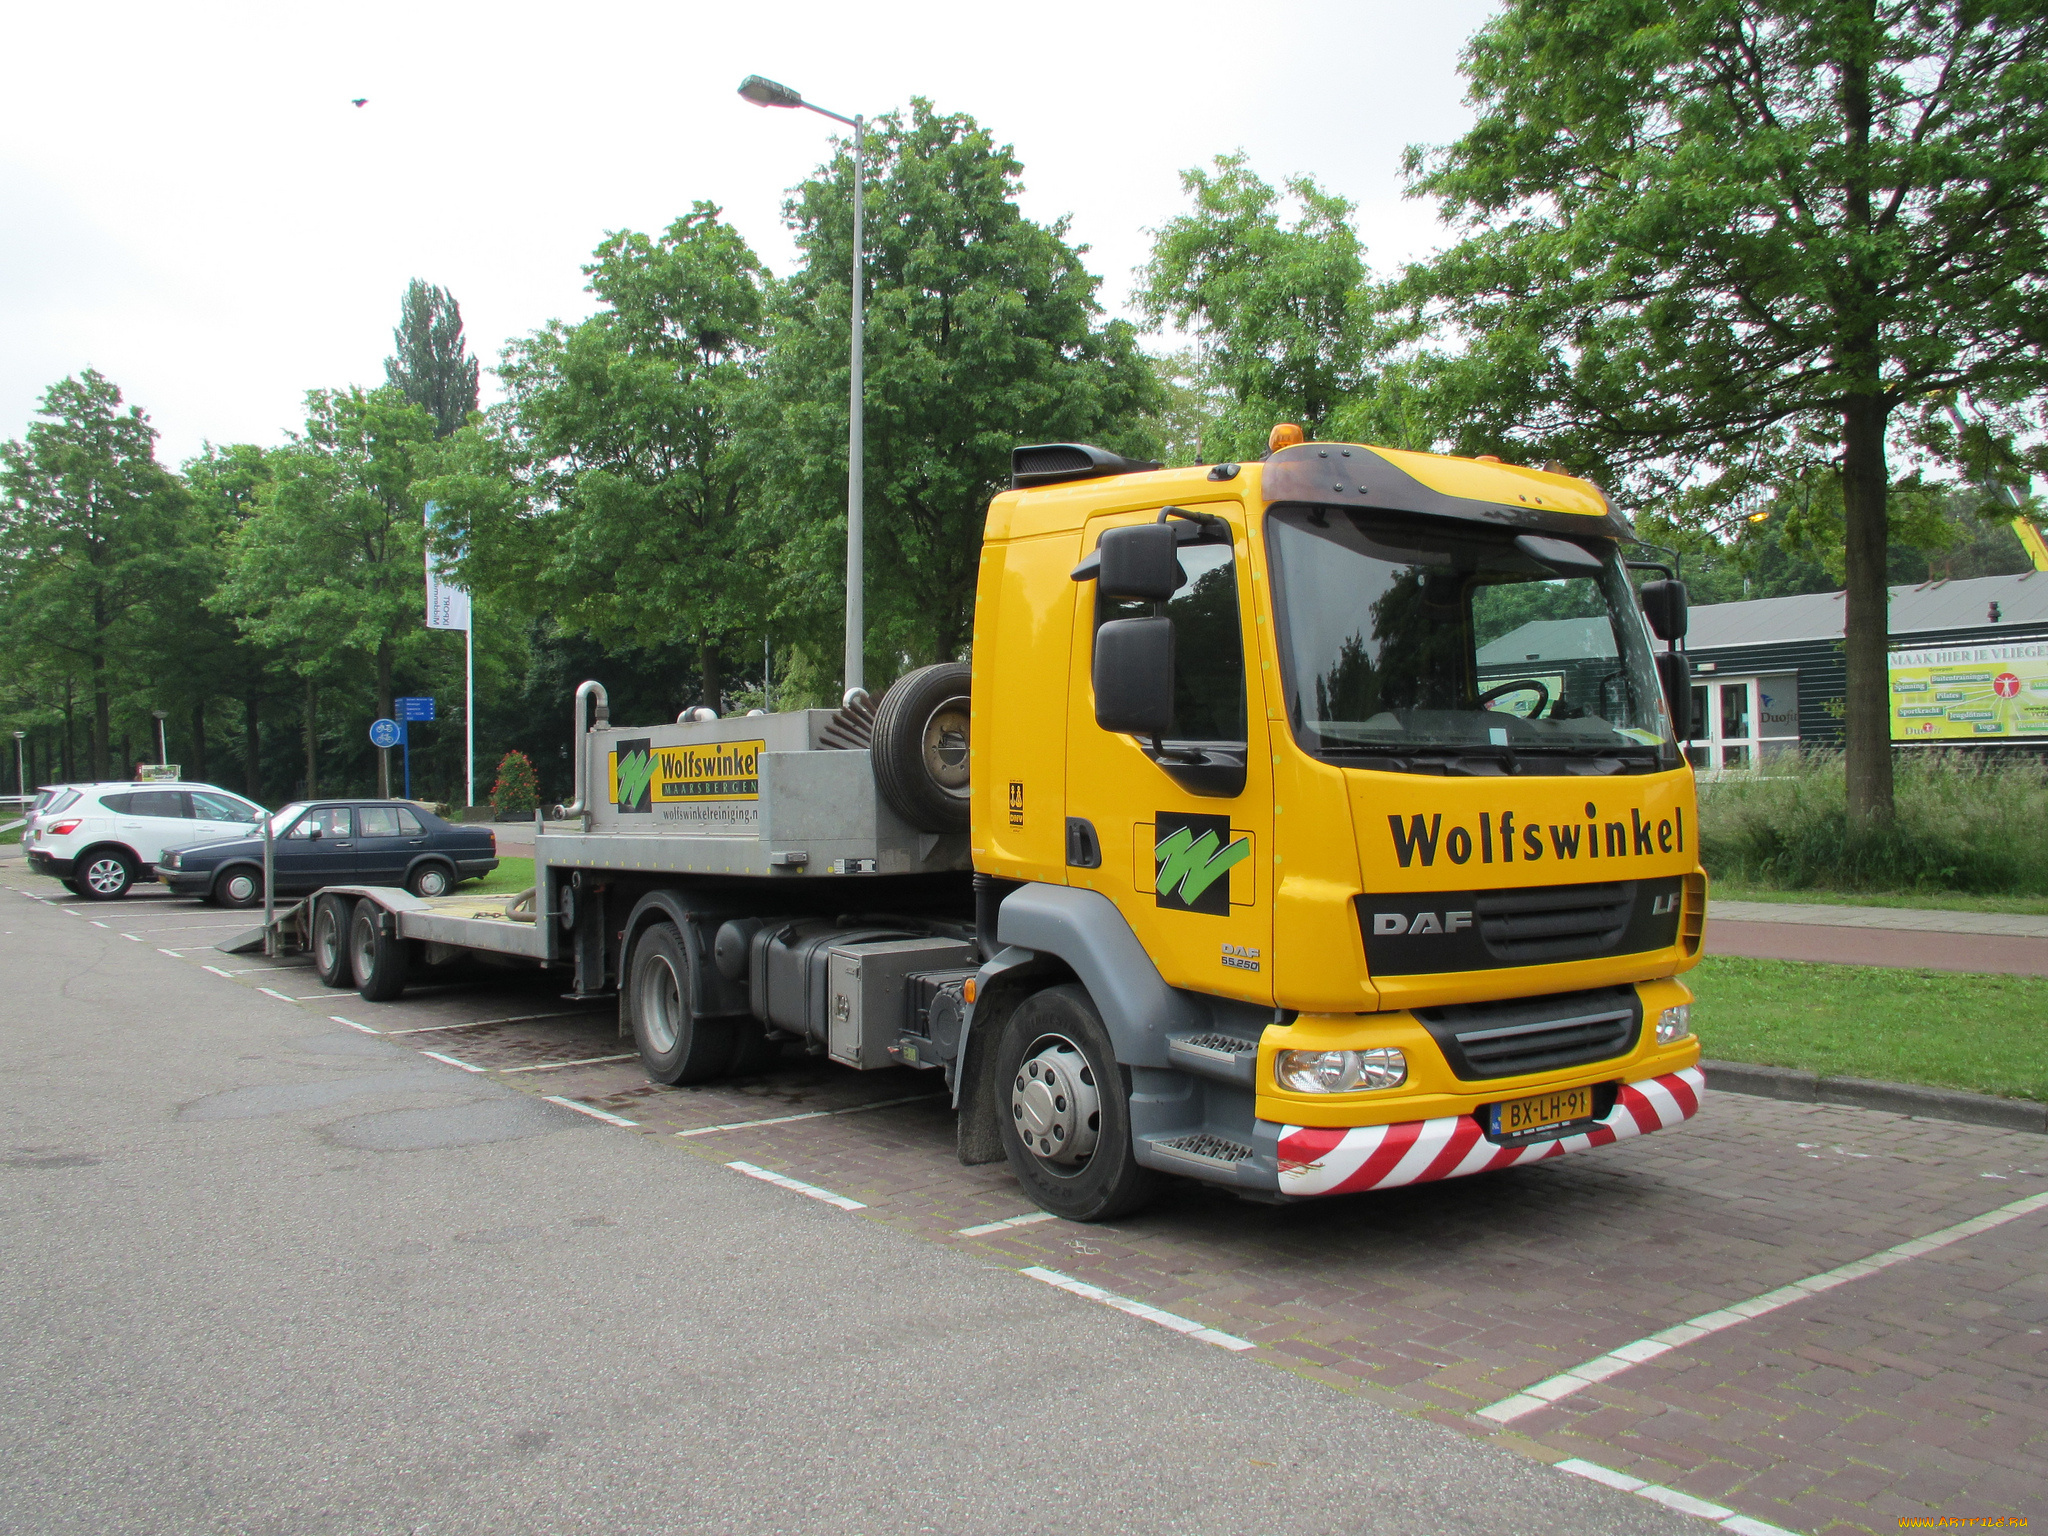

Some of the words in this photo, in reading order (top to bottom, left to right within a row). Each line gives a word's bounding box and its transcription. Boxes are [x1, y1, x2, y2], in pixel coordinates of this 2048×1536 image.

[1890, 653, 1934, 666] MAAK
[1937, 650, 1971, 663] HIER
[1974, 650, 1987, 661] JE
[1894, 684, 1926, 692] Spinning
[1761, 710, 1798, 726] Duofit
[1900, 707, 1940, 717] Sportkracht
[1978, 724, 1996, 732] Yoga
[661, 745, 759, 780] Wolfswinkel
[664, 781, 757, 795] MAARSBERGEN
[663, 805, 758, 824] wolfswinkelreiniging.n
[1387, 801, 1684, 869] Wolfswinkel
[1652, 892, 1680, 915] LF
[1373, 911, 1473, 935] DAF
[1221, 943, 1260, 958] DAF
[1221, 956, 1259, 970] 55.250
[1511, 1091, 1585, 1128] BX-LH-91
[1492, 1122, 1499, 1130] NL
